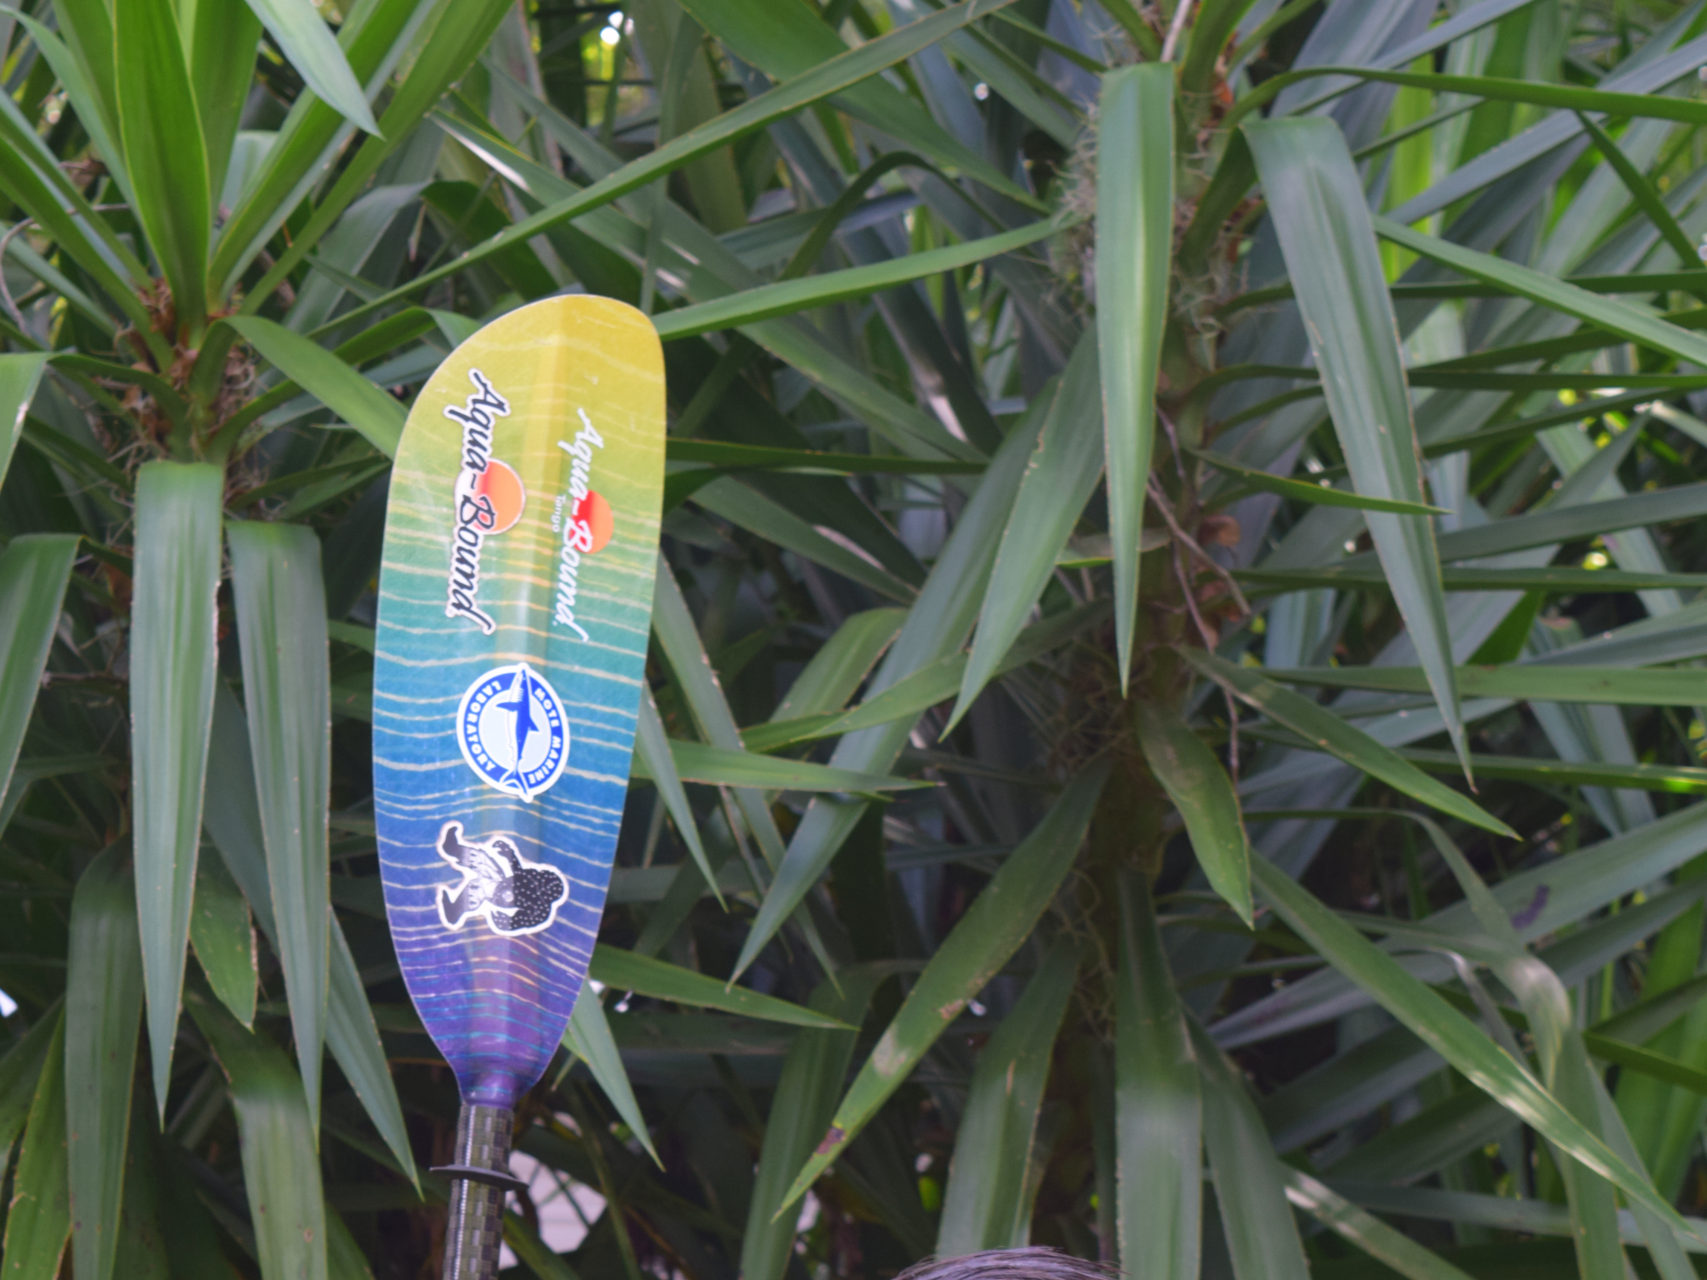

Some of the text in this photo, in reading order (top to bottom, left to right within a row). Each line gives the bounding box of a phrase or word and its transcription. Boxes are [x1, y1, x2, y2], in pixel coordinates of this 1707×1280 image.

[447, 371, 508, 631] Aqua-Bound
[553, 494, 566, 533] Tango
[556, 408, 604, 642] Aqua-Bound
[466, 680, 502, 772] LABORATORY
[528, 687, 562, 785] MOTE MARINE
